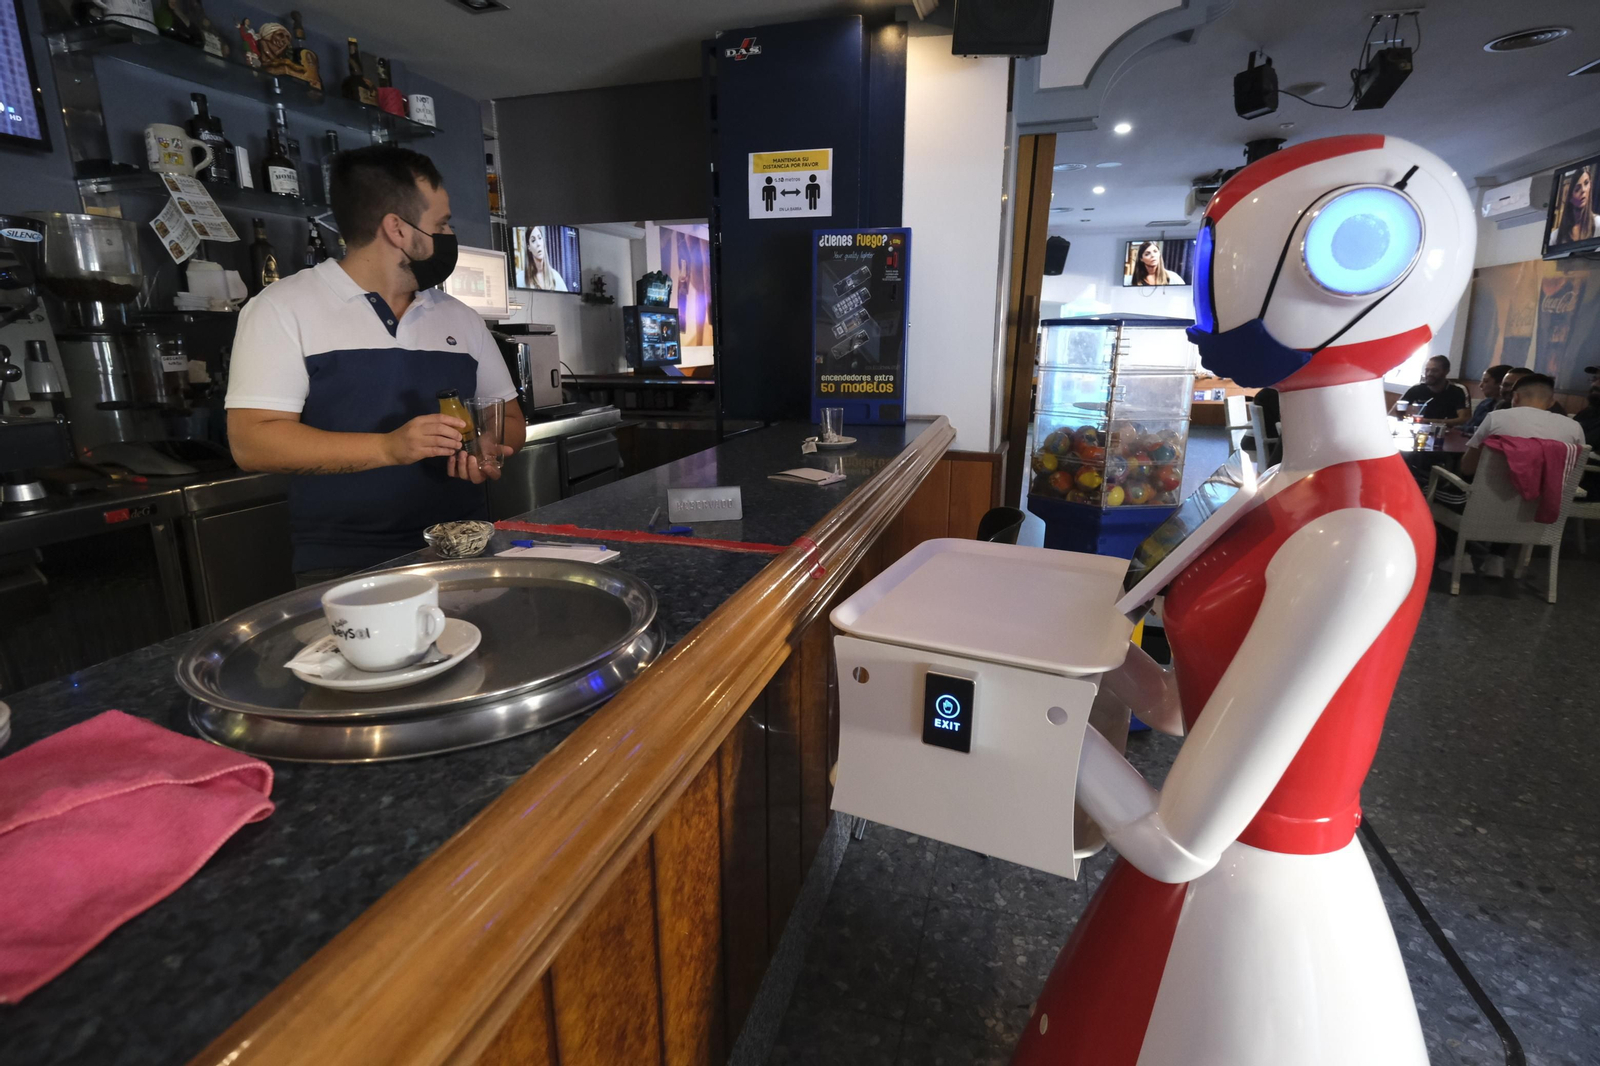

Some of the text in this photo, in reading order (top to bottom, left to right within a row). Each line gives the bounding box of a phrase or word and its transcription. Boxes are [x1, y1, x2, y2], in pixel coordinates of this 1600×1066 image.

[726, 46, 760, 56] DAS
[856, 233, 888, 248] fuego?
[844, 251, 859, 262] quality
[860, 251, 875, 262] lighter
[820, 374, 894, 382] encendedores extra
[820, 381, 894, 393] 50 modelos
[934, 718, 961, 731] EXIT
